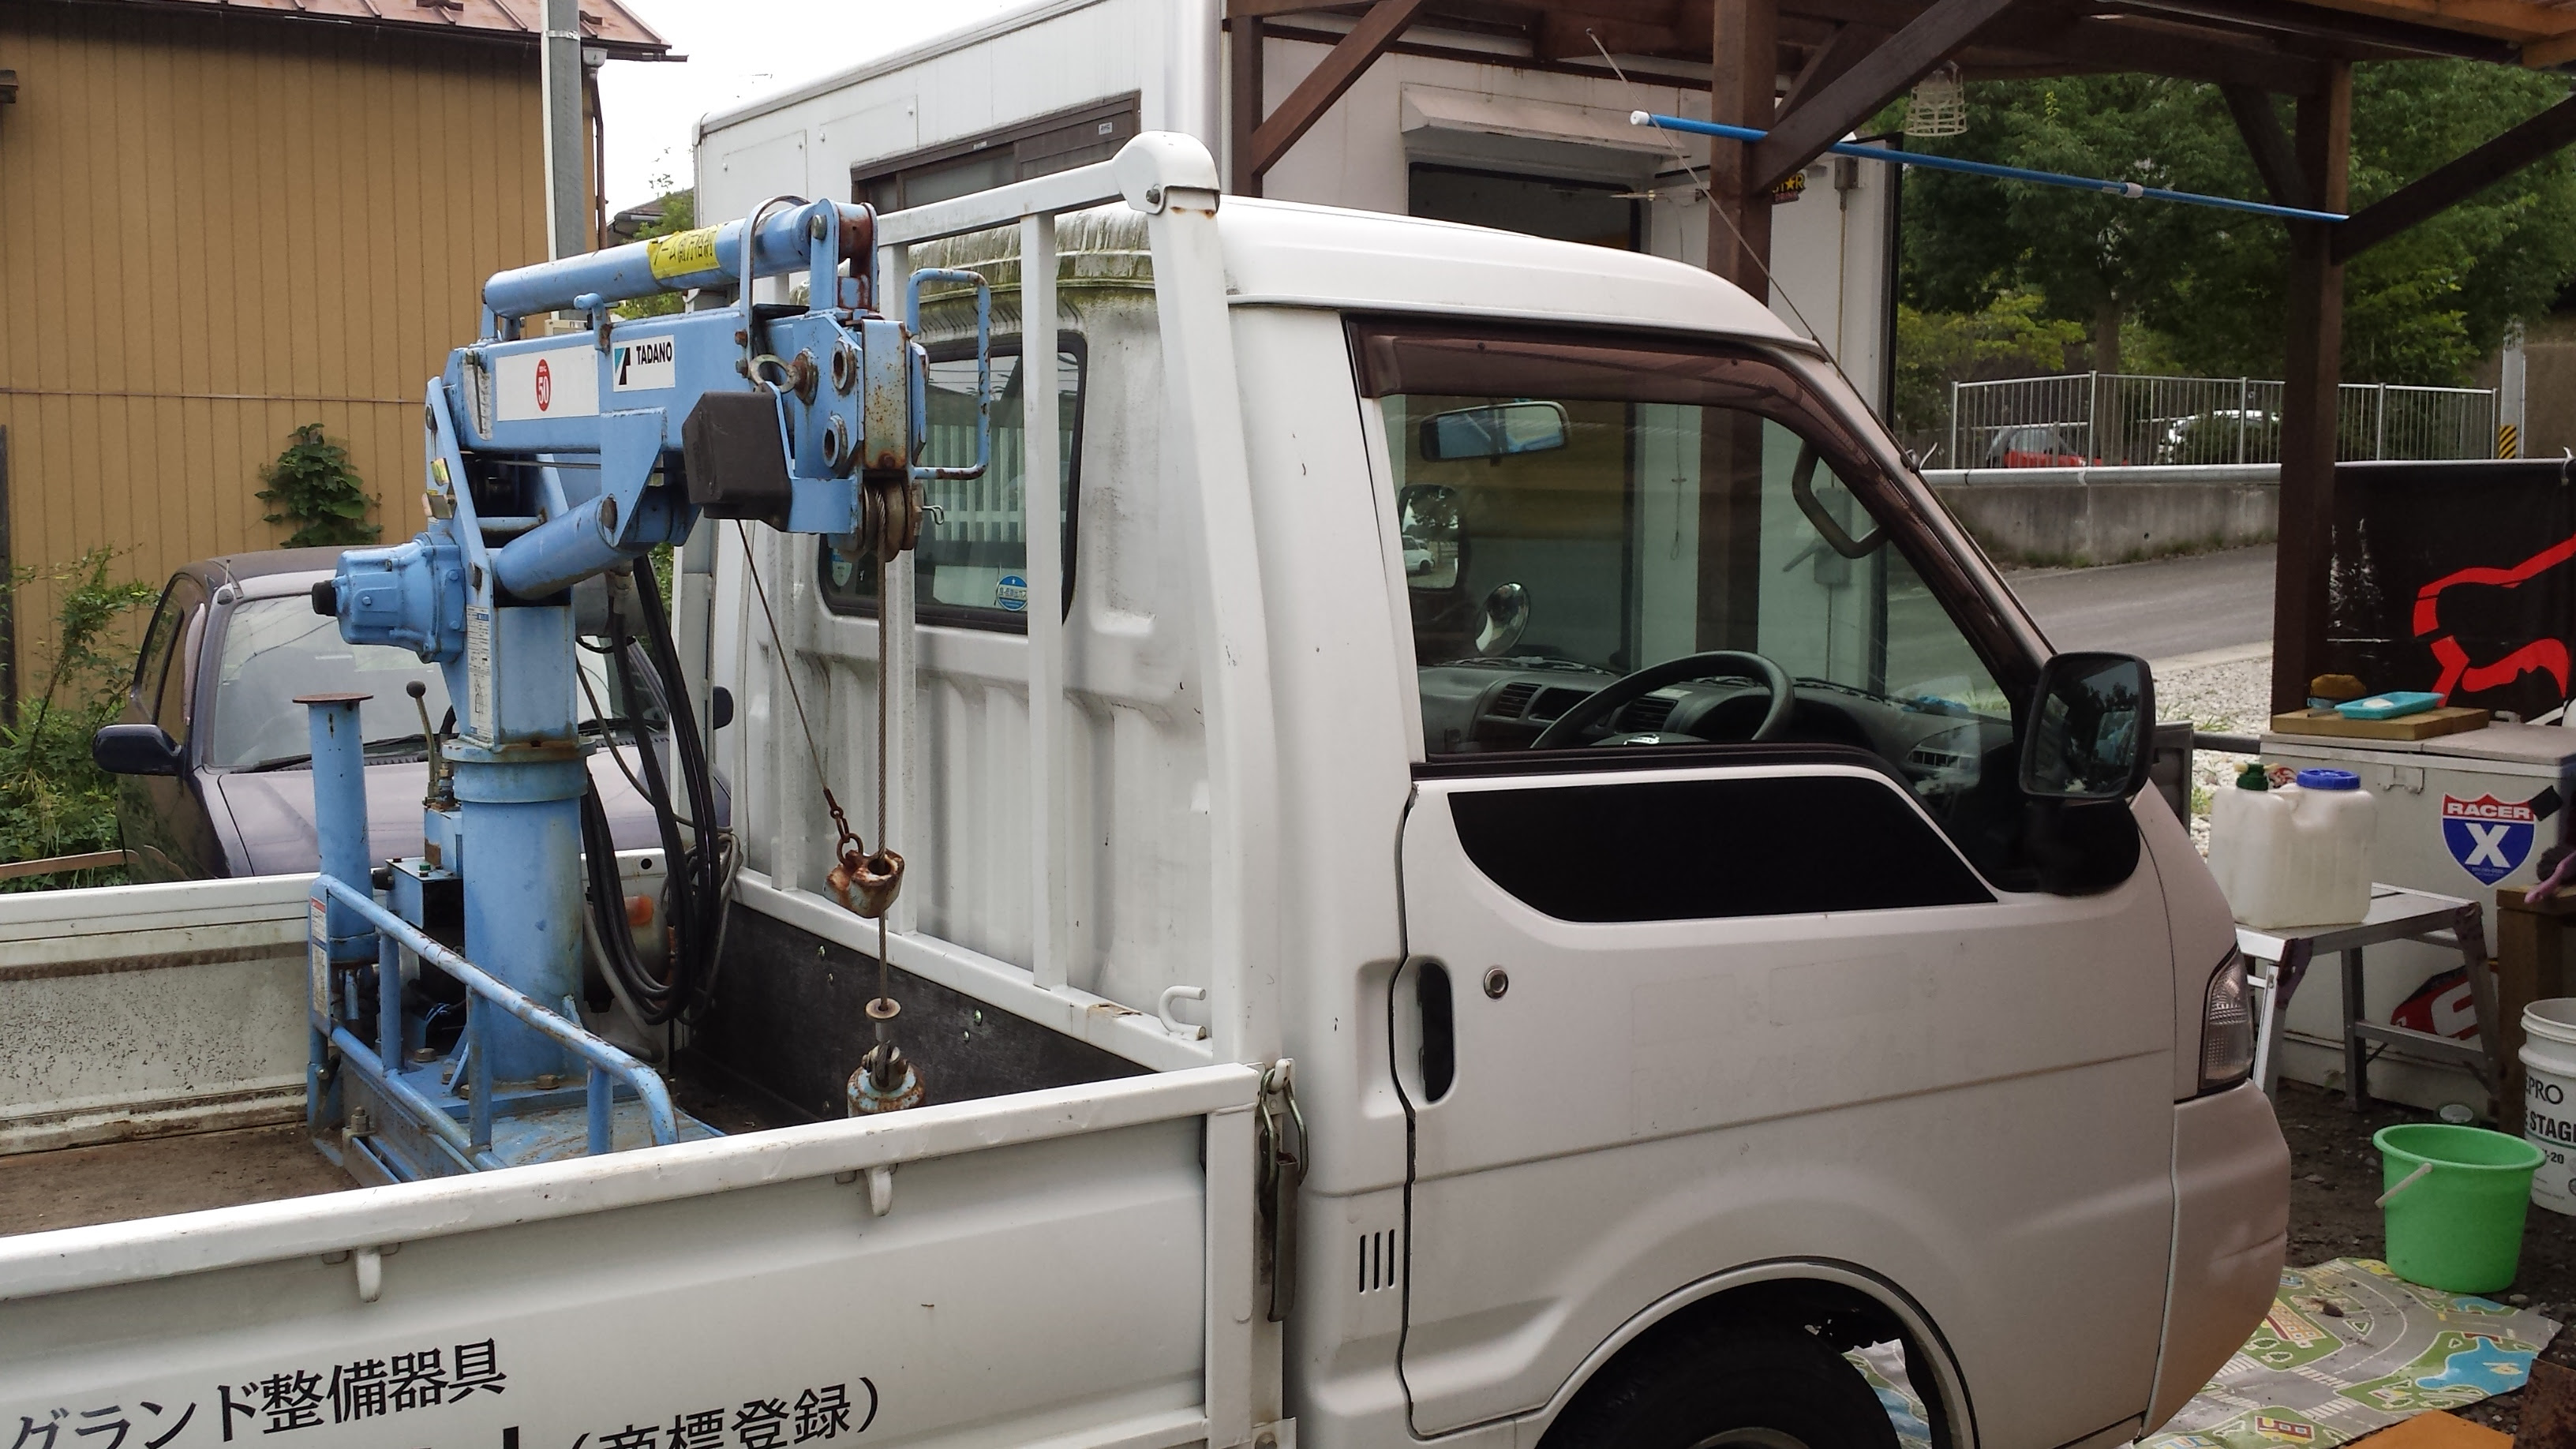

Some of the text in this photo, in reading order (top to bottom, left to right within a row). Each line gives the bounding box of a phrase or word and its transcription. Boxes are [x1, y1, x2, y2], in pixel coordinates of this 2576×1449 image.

[635, 341, 672, 365] TADANO
[537, 375, 549, 405] 50
[2447, 802, 2531, 820] RACER
[2464, 822, 2512, 869] X
[2529, 1110, 2576, 1144] STAG
[2544, 1148, 2565, 1165] -20
[12, 1337, 507, 1449] グランド整備器具
